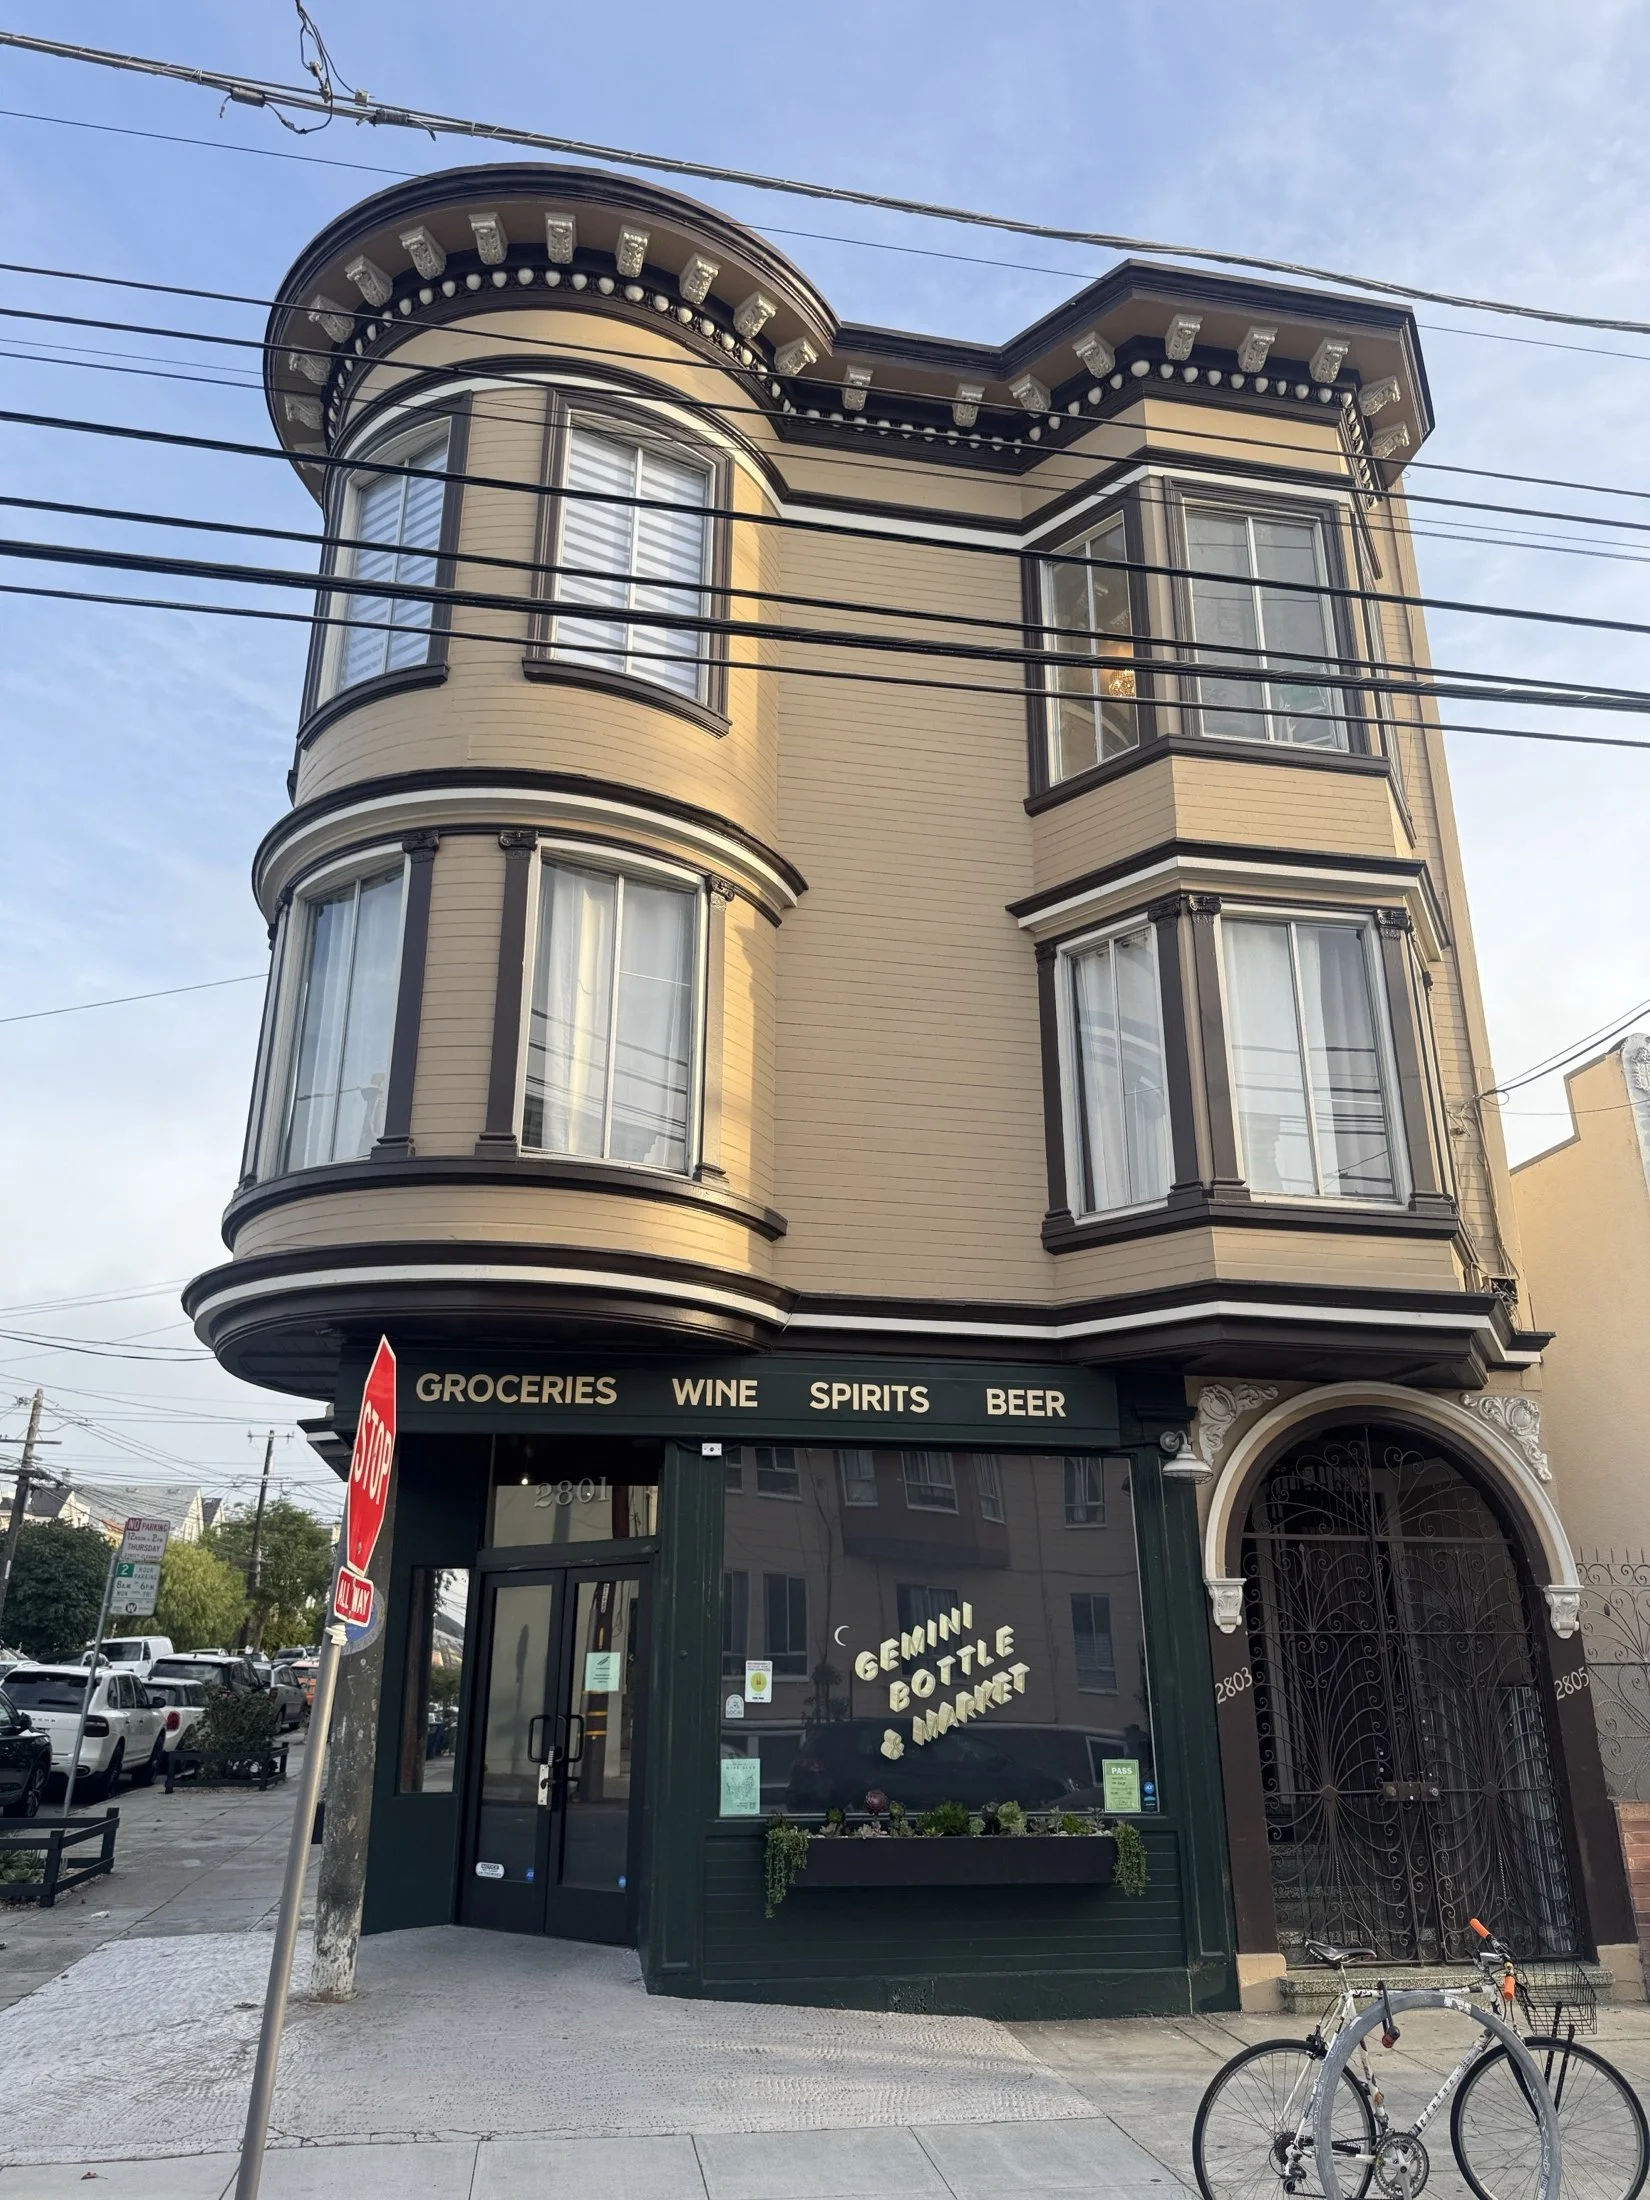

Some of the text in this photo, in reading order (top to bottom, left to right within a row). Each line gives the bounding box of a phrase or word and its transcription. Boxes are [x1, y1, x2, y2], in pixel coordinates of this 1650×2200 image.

[416, 1373, 1067, 1417] GROCERIES WINE SPIRITS BEER
[354, 1399, 392, 1505] STOP
[534, 1476, 609, 1508] 2801
[128, 1519, 169, 1532] NO PARKING
[127, 1542, 160, 1552] THURSDAY
[121, 1564, 129, 1575] 2
[337, 1579, 370, 1616] ALL WAY
[855, 1601, 973, 1681] GEMINI
[889, 1625, 1014, 1713] BOTTLE
[1214, 1666, 1253, 1705] 2803
[1554, 1666, 1590, 1701] 2805
[880, 1662, 1031, 1760] & MARKET
[1111, 1767, 1133, 1775] PASS
